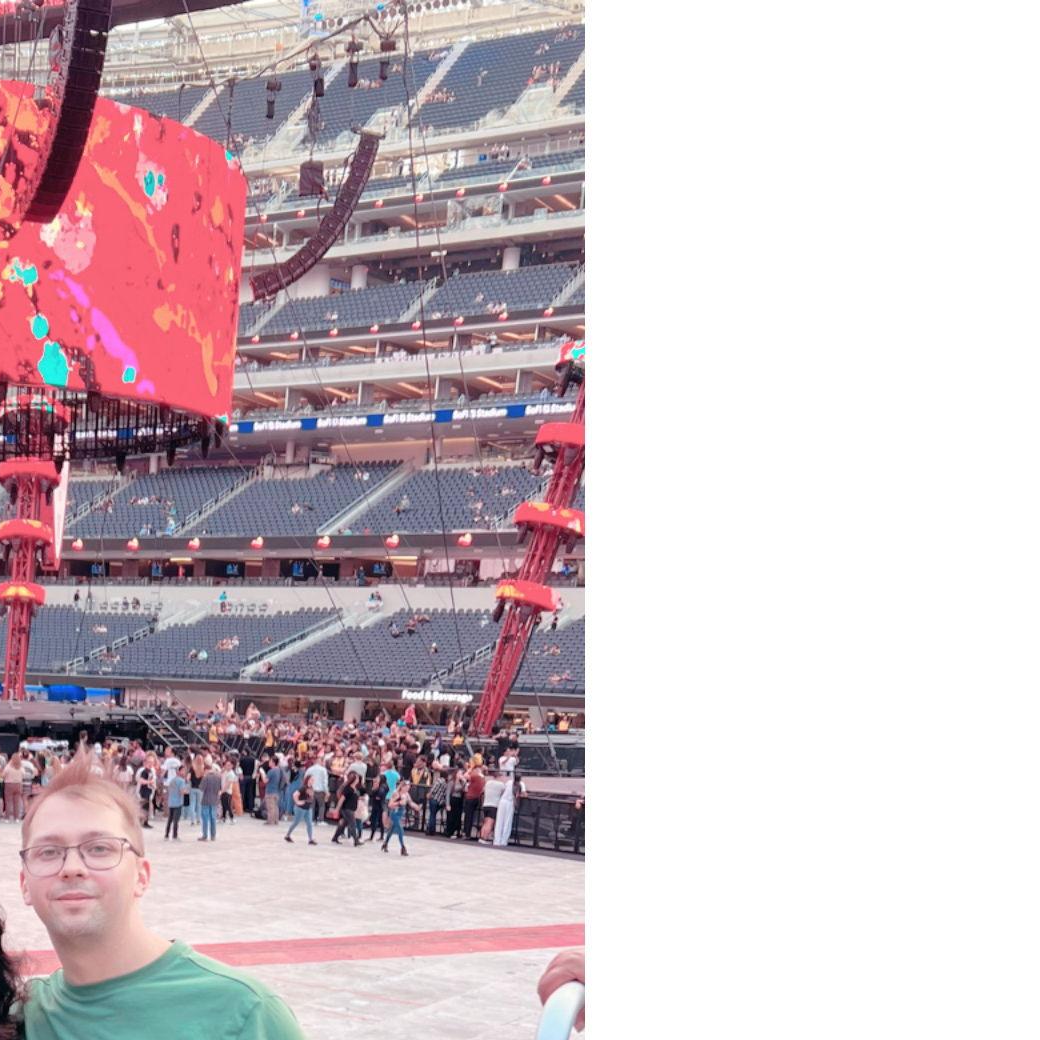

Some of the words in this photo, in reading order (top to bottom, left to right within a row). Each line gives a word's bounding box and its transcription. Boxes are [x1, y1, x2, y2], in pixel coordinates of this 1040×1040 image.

[551, 403, 576, 413] Stadiu
[402, 689, 424, 700] Food
[433, 691, 473, 703] Beverage
